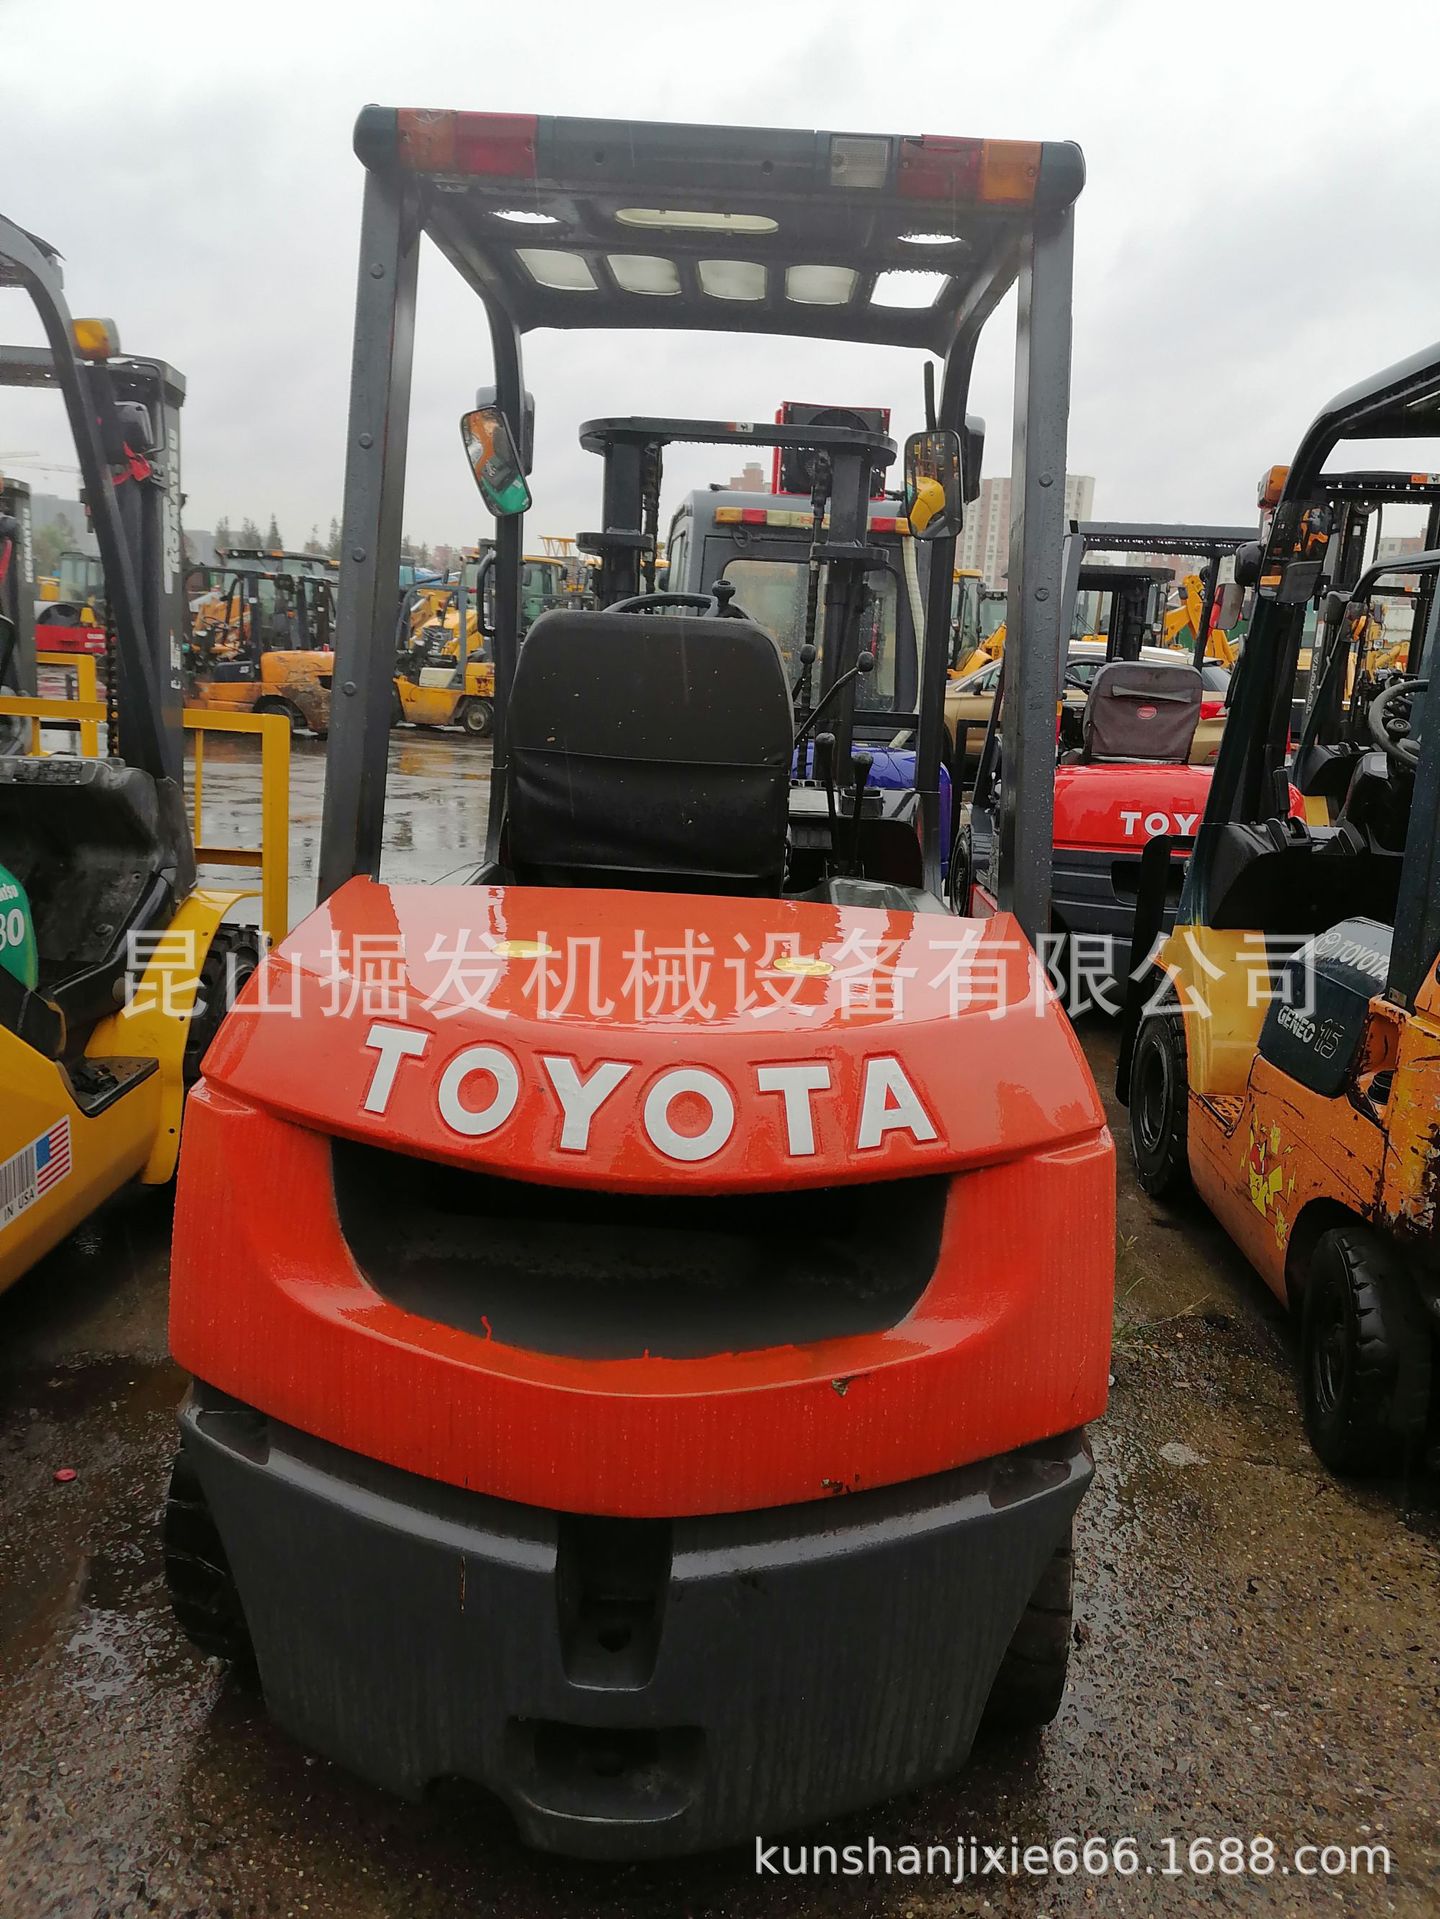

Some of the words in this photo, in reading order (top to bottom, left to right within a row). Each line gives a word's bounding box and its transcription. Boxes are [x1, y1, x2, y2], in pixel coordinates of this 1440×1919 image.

[1277, 1005, 1316, 1043] GENEO
[364, 1024, 938, 1161] TOYOTA
[17, 1187, 35, 1209] USA
